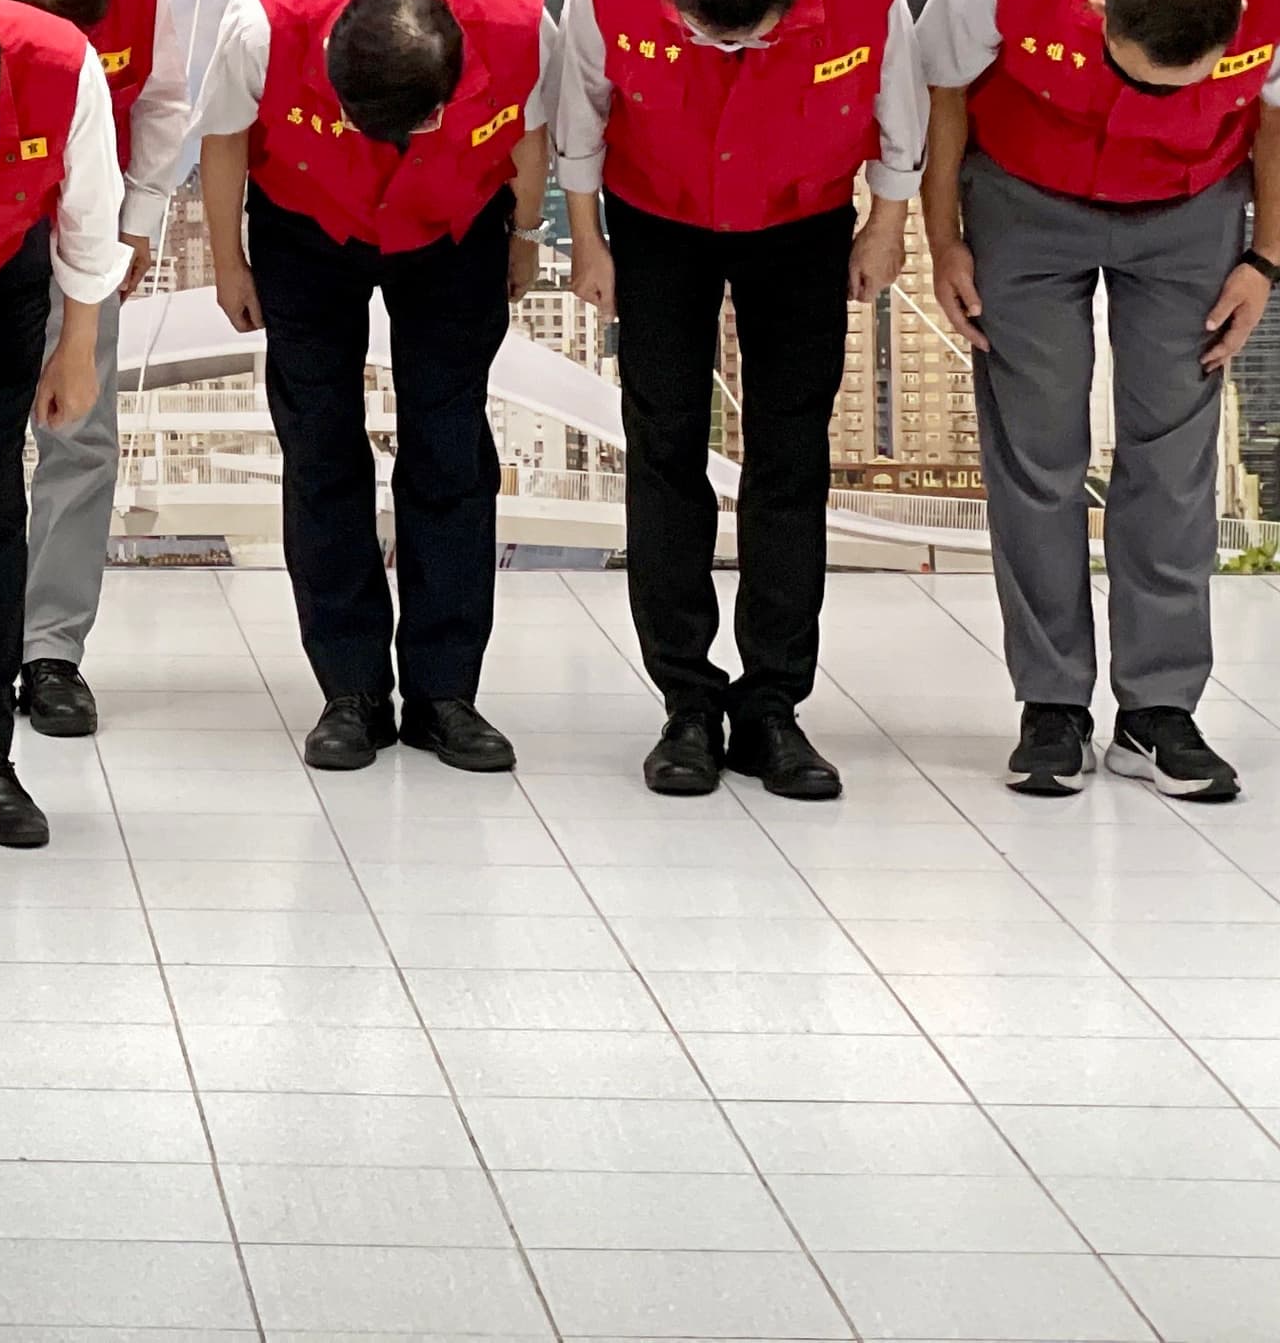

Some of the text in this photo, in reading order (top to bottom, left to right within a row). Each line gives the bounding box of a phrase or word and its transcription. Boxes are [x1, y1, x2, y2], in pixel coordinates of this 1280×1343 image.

[617, 32, 682, 65] 高雄市
[1020, 36, 1087, 70] 高雄市
